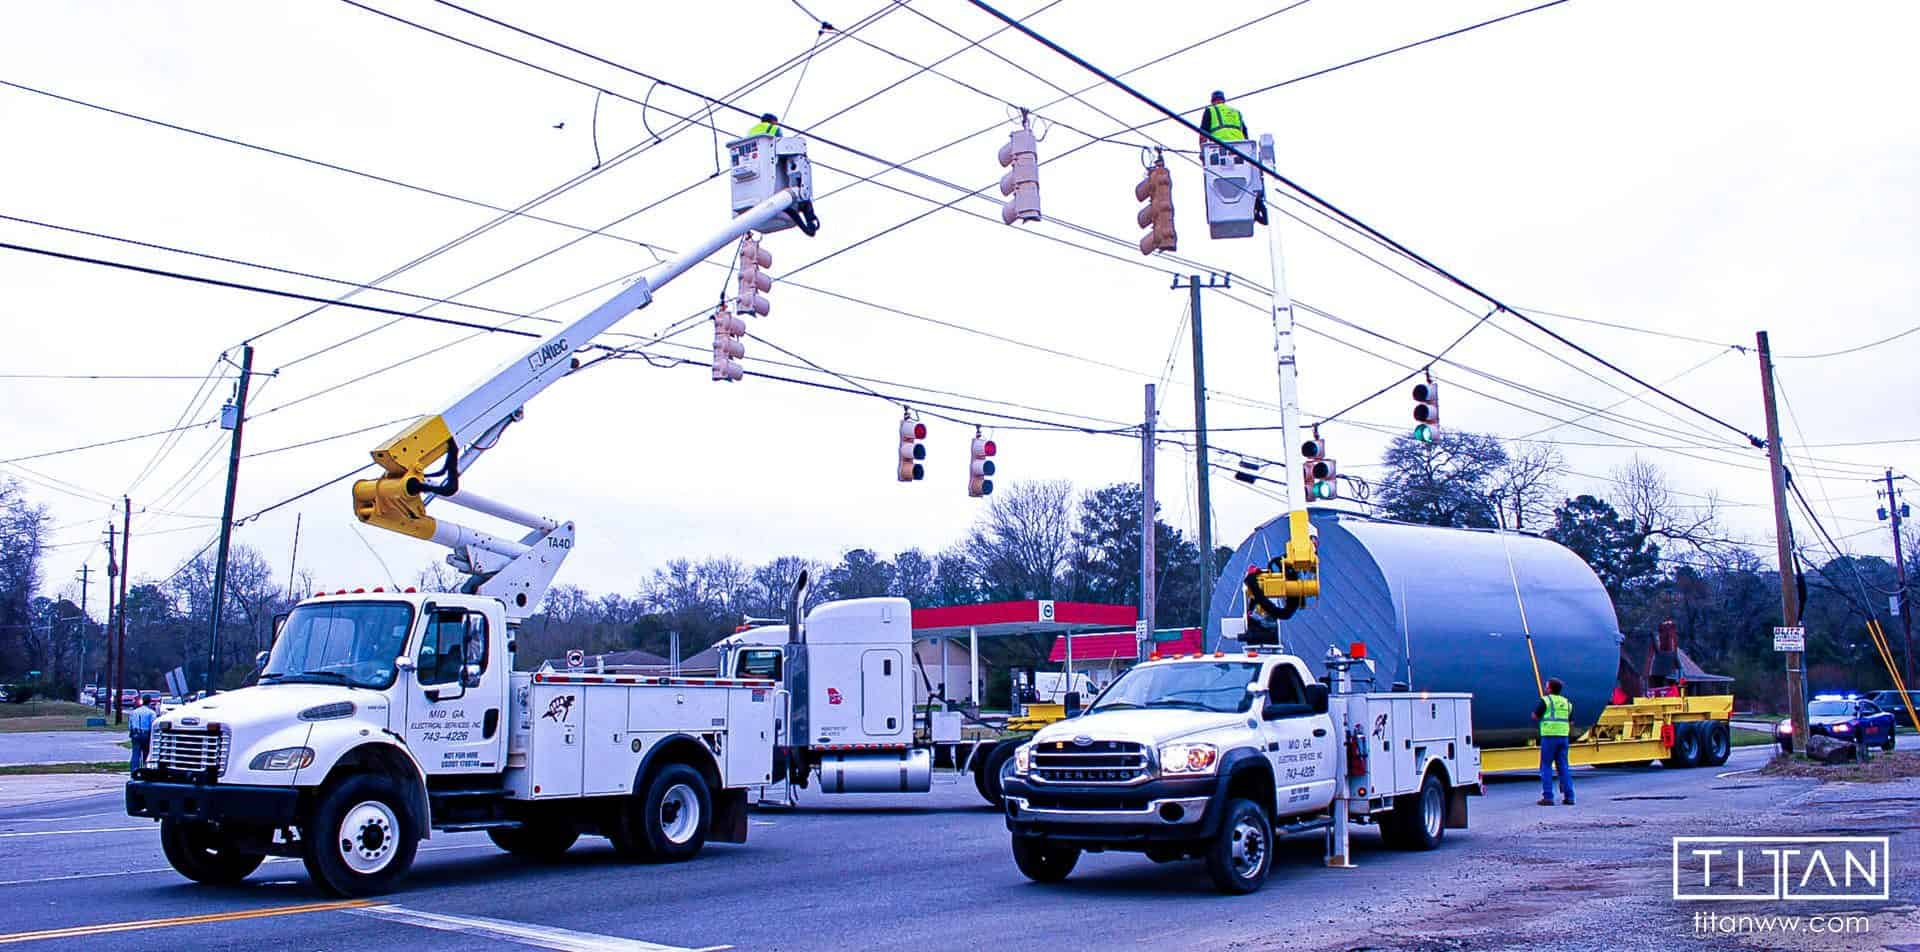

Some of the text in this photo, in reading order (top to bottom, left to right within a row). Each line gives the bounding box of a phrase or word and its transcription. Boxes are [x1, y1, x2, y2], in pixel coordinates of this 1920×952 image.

[541, 338, 568, 364] Altec
[547, 536, 571, 549] TA40
[428, 710, 447, 719] MID
[422, 731, 469, 741] 743-4226
